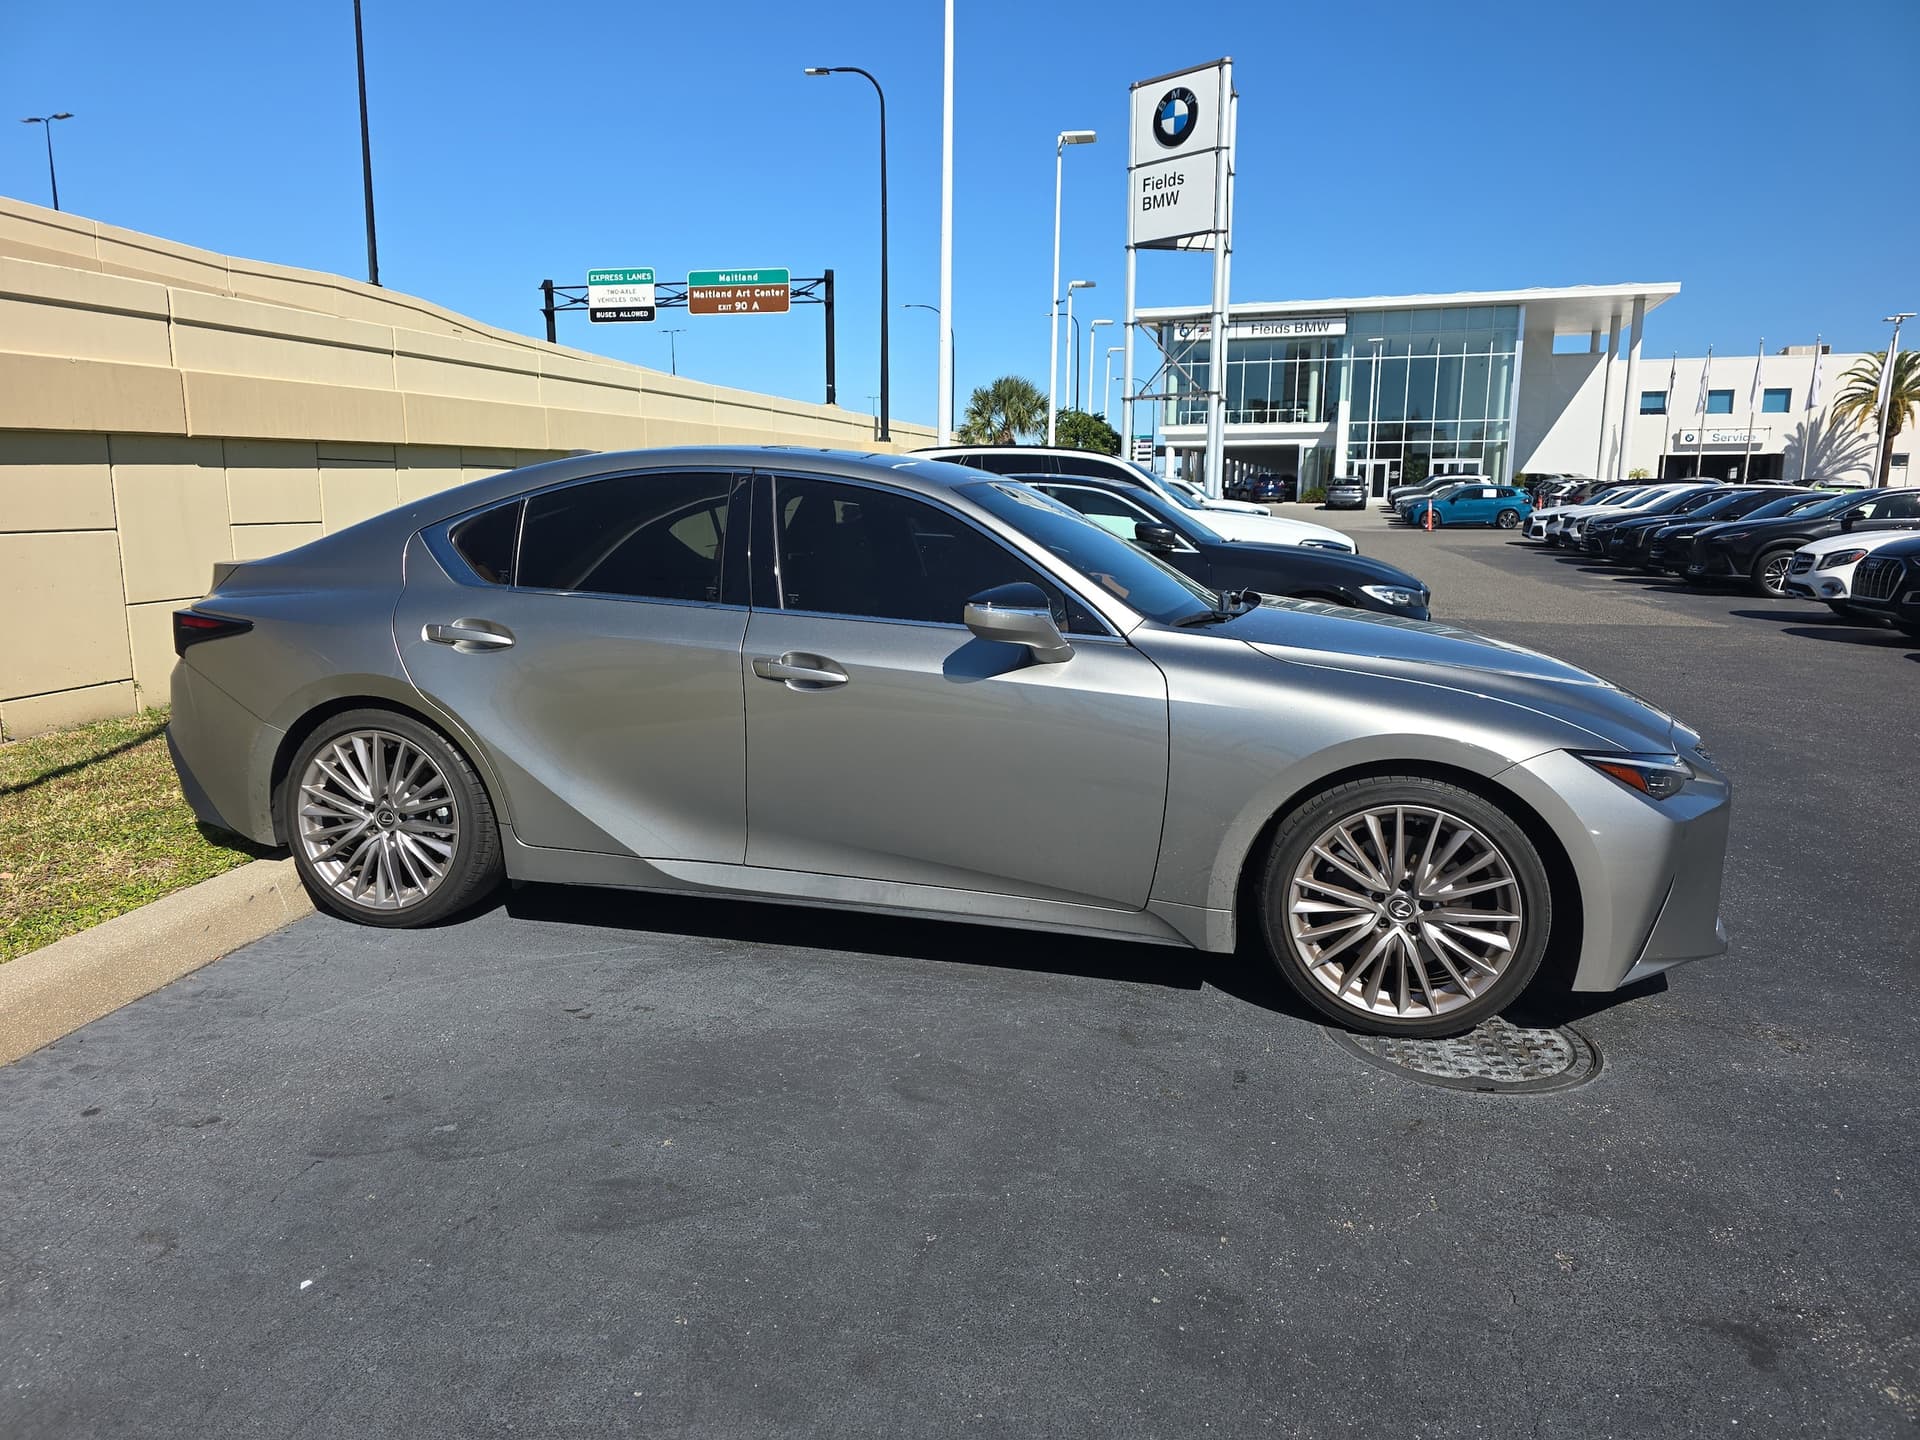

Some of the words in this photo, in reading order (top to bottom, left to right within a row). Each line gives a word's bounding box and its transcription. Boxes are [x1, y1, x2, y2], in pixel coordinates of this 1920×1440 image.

[1142, 171, 1185, 193] Fields
[1142, 190, 1180, 211] BMW
[718, 273, 759, 282] Maitland
[693, 290, 732, 299] Maitland
[735, 289, 751, 298] Art
[754, 288, 785, 298] Center
[718, 303, 732, 311] EXIT
[735, 301, 748, 311] 90
[752, 301, 760, 310] A
[1251, 323, 1291, 335] Fields
[1294, 321, 1330, 333] BMW
